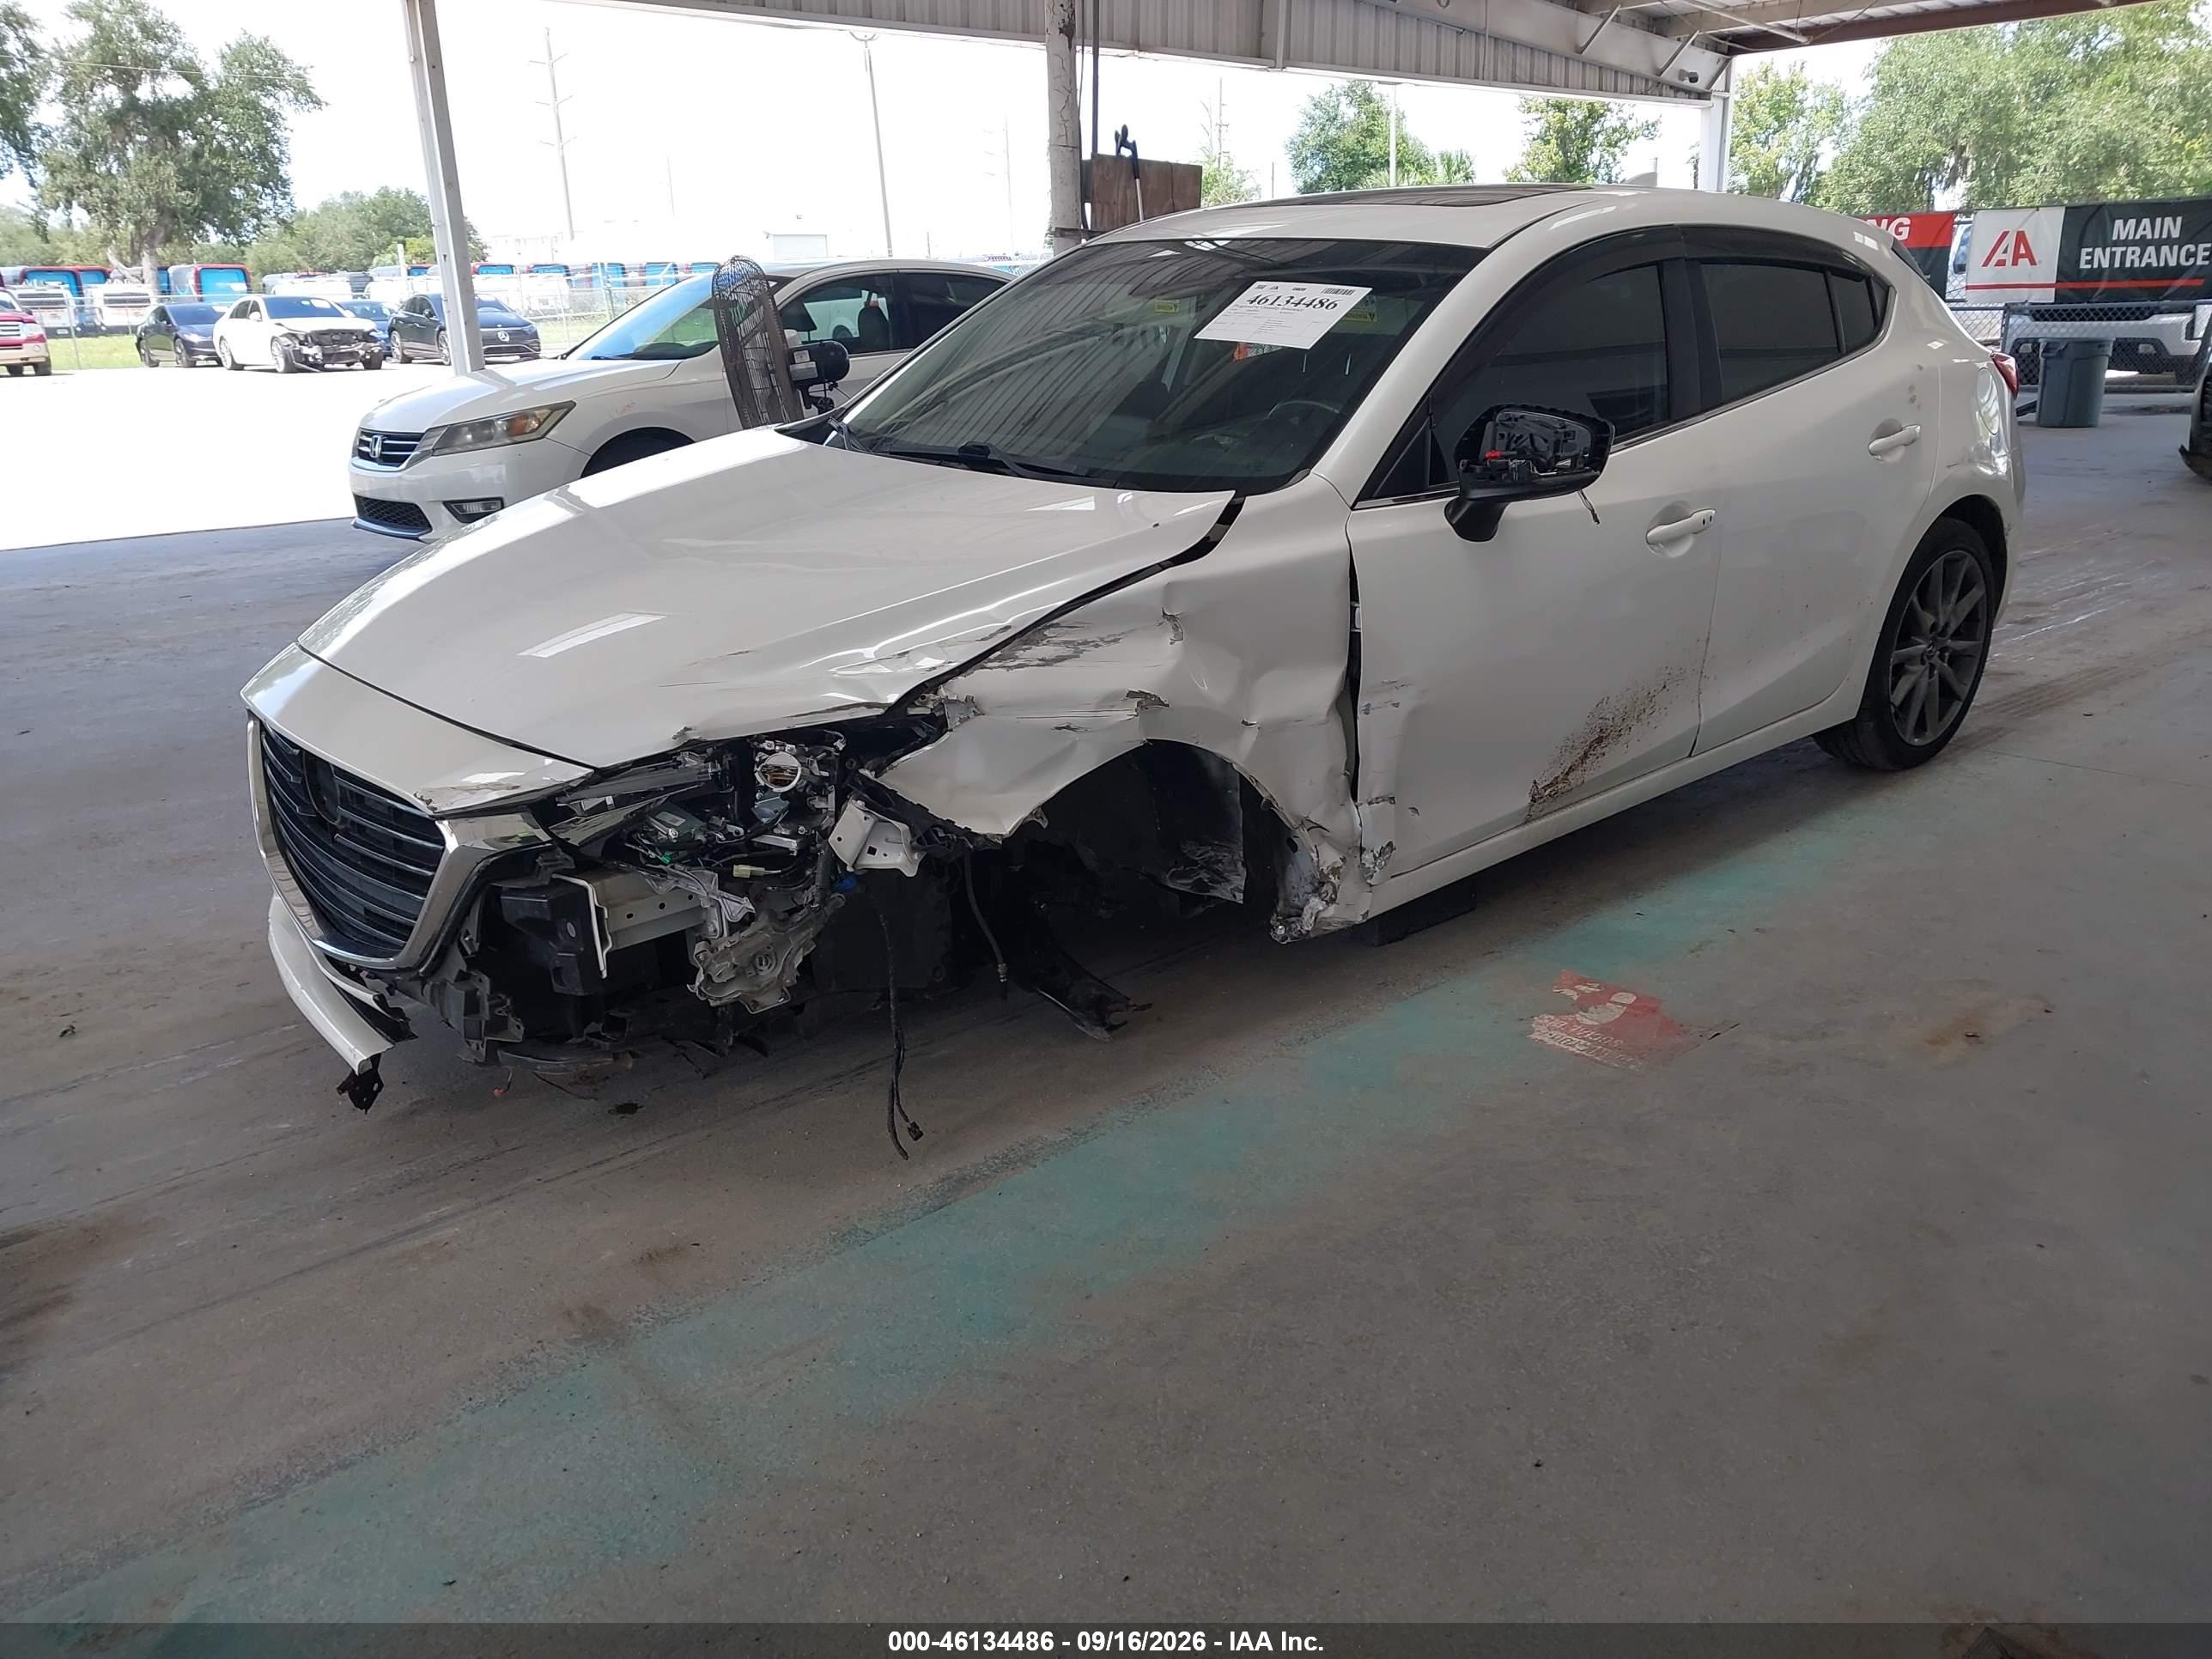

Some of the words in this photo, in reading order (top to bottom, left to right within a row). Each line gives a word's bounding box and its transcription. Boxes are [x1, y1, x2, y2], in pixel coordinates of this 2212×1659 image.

[2112, 216, 2183, 240] MAIN
[2079, 243, 2212, 269] ENTRANCE
[1246, 294, 1344, 311] 46134486
